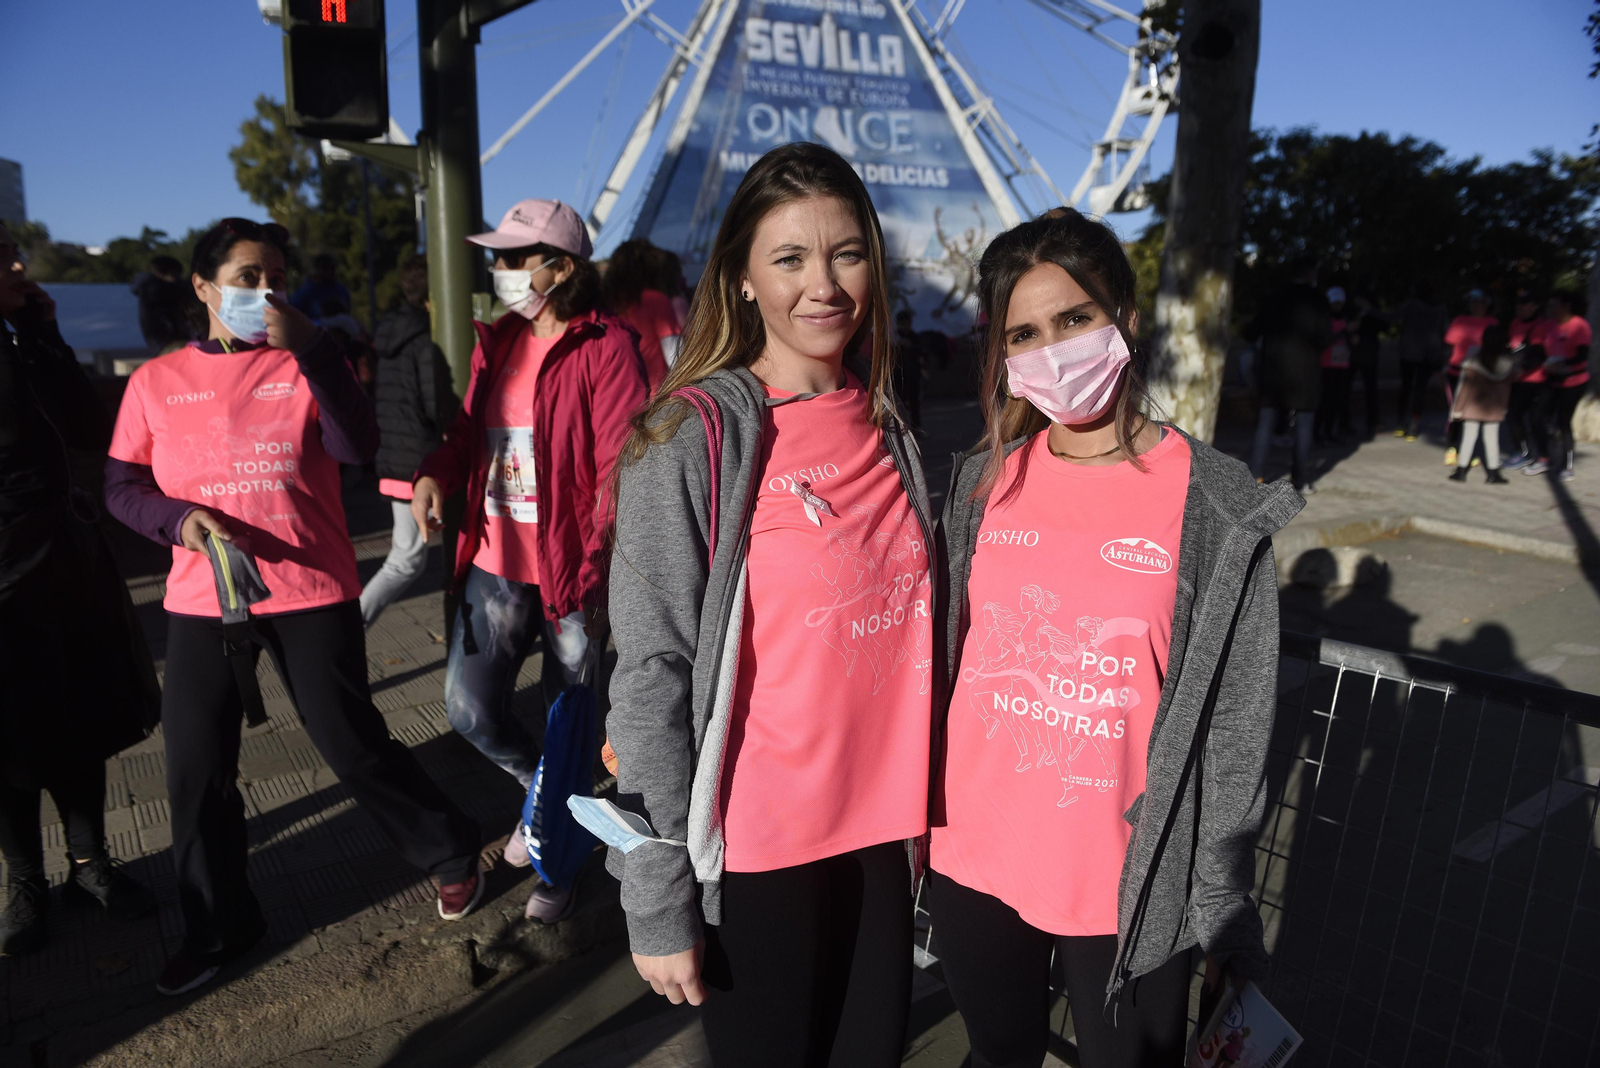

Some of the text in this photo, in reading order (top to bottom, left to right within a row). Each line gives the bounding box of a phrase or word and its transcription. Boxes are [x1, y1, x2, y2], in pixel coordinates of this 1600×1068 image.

[745, 12, 906, 79] SEVILLA
[865, 163, 949, 188] DELICIAS
[166, 390, 216, 406] OYSHO
[255, 442, 293, 456] POR
[232, 459, 295, 475] TODAS
[200, 478, 295, 498] NOSOTRAS
[978, 529, 1040, 547] OYSHO
[1105, 545, 1167, 570] ASTURIANA
[892, 568, 931, 596] TODA
[852, 599, 931, 640] NOSOTR
[1080, 651, 1137, 676] POR
[1046, 673, 1131, 708] TODAS
[994, 692, 1126, 740] NOSOTRAS
[1094, 778, 1119, 788] 2021
